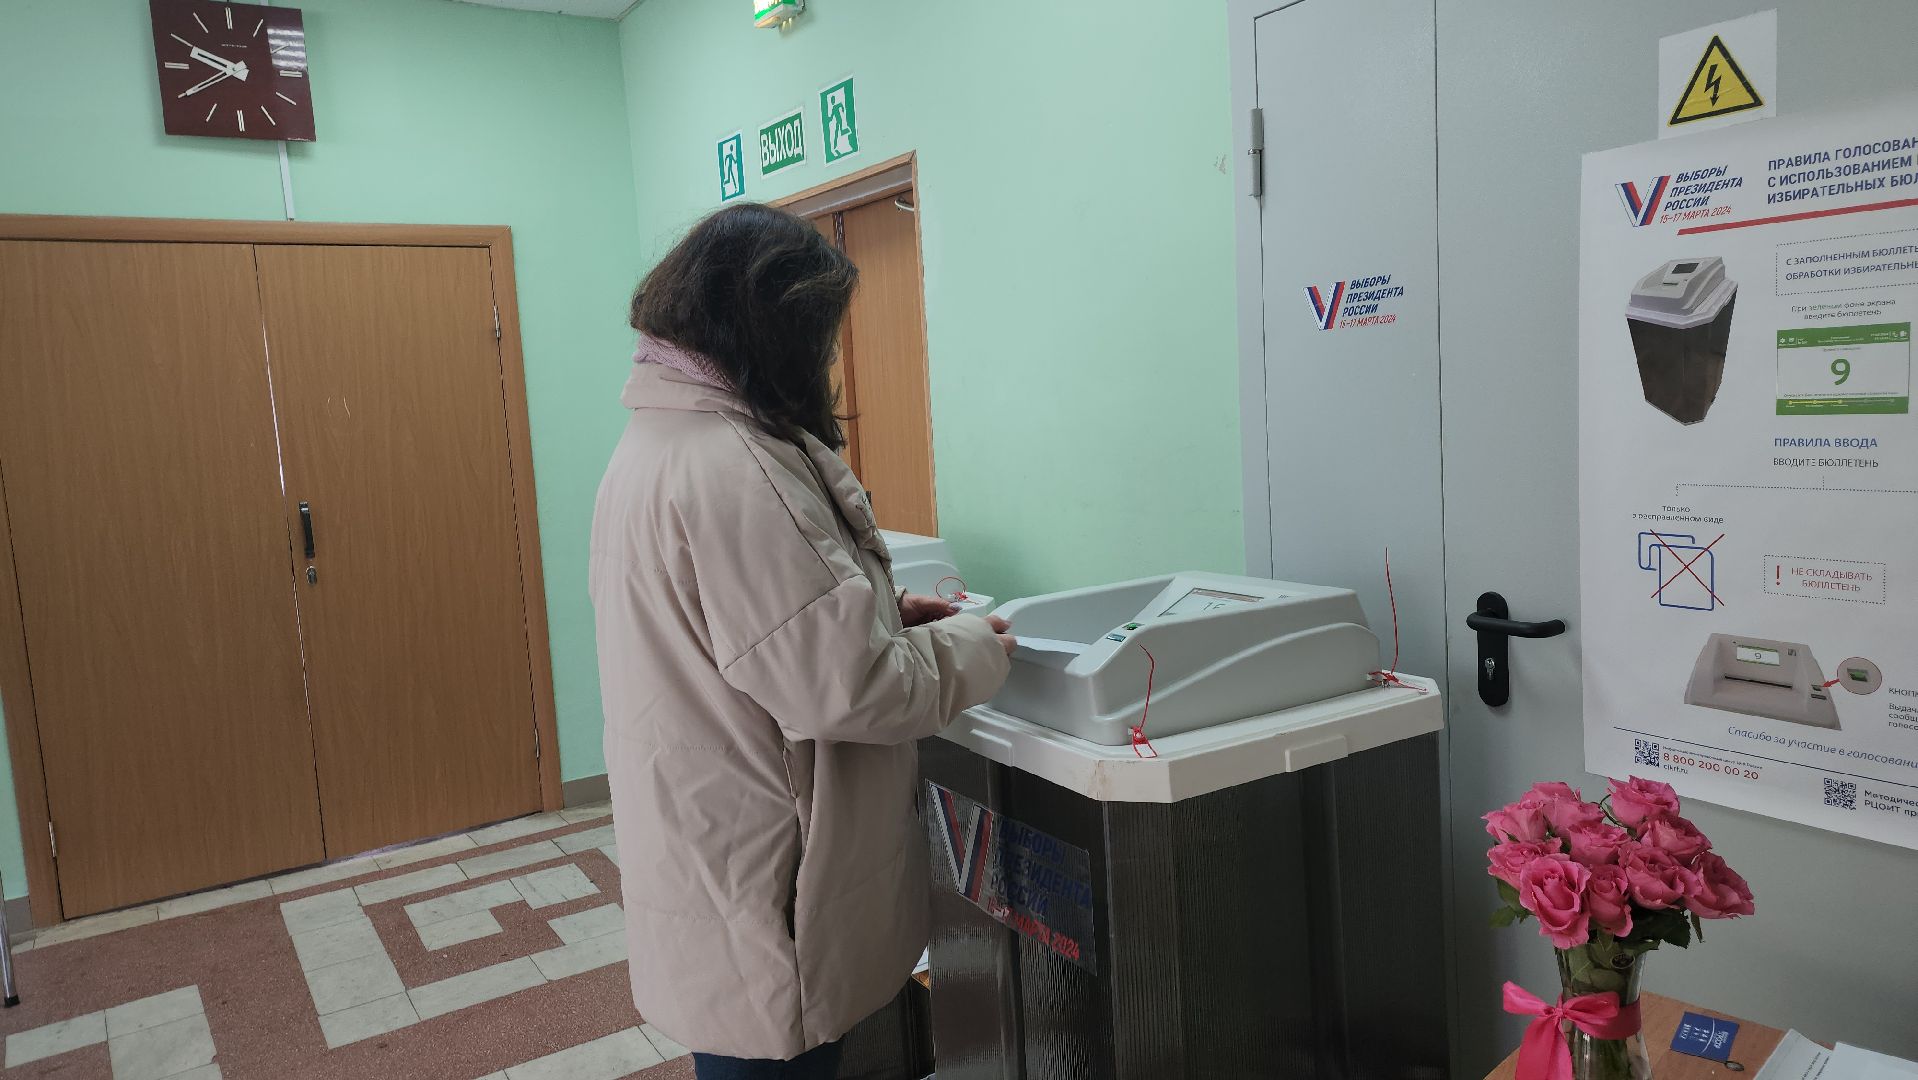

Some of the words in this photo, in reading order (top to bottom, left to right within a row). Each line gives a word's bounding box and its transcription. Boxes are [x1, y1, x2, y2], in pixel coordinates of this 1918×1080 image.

[760, 119, 804, 166] ВЫХОД
[1768, 151, 1831, 171] ПРАВИЛА
[1676, 164, 1728, 184] ВЫБОРЫ
[1767, 176, 1776, 188] С
[1779, 155, 1912, 186] ИСПОЛЬЗОВАНИЕМ
[1670, 177, 1743, 198] ПРЕЗИДЕНТА
[1767, 176, 1886, 204] ИЗБИРАТЕЛЬНЫХ
[1664, 196, 1710, 212] РОССИИ
[1682, 209, 1710, 220] МАРТА
[1711, 205, 1732, 217] 2024
[1786, 257, 1793, 266] С
[1794, 250, 1870, 265] ЗАПОЛНЕННЫМ
[1350, 274, 1391, 290] ВЫБОРЫ
[1785, 267, 1841, 281] ОБРАБОТКИ
[1346, 286, 1404, 304] ПРЕЗИДЕНТА
[1342, 304, 1378, 317] РОССИИ
[1357, 315, 1379, 326] МАРТА
[1380, 314, 1396, 324] 2024
[1830, 358, 1851, 386] 9
[1774, 437, 1831, 448] ПРАВИЛА
[1834, 438, 1878, 449] ВВОДА
[1773, 457, 1816, 468] ВВОДИТЕ
[1818, 458, 1879, 468] БЮЛЛЕТЕНЬ
[1791, 567, 1804, 576] НЕ
[1806, 568, 1873, 582] СКЛАДЫВАТЬ
[1802, 580, 1861, 592] БЮЛЛЕТЕНЬ
[1889, 703, 1918, 714] Выдач
[1728, 726, 1772, 742] Спасибо
[1773, 736, 1786, 745] за
[1787, 738, 1837, 754] участие
[1663, 752, 1670, 761] 8
[1672, 754, 1695, 766] 800
[1698, 760, 1720, 772] 200
[1724, 765, 1740, 776] 00
[1743, 769, 1759, 780] 20
[1000, 817, 1065, 862] ВЫБОРЫ
[993, 849, 1091, 908] ПРЕЗИДЕНТА
[991, 873, 1049, 916] РОССИИ
[1051, 930, 1081, 961] 2024
